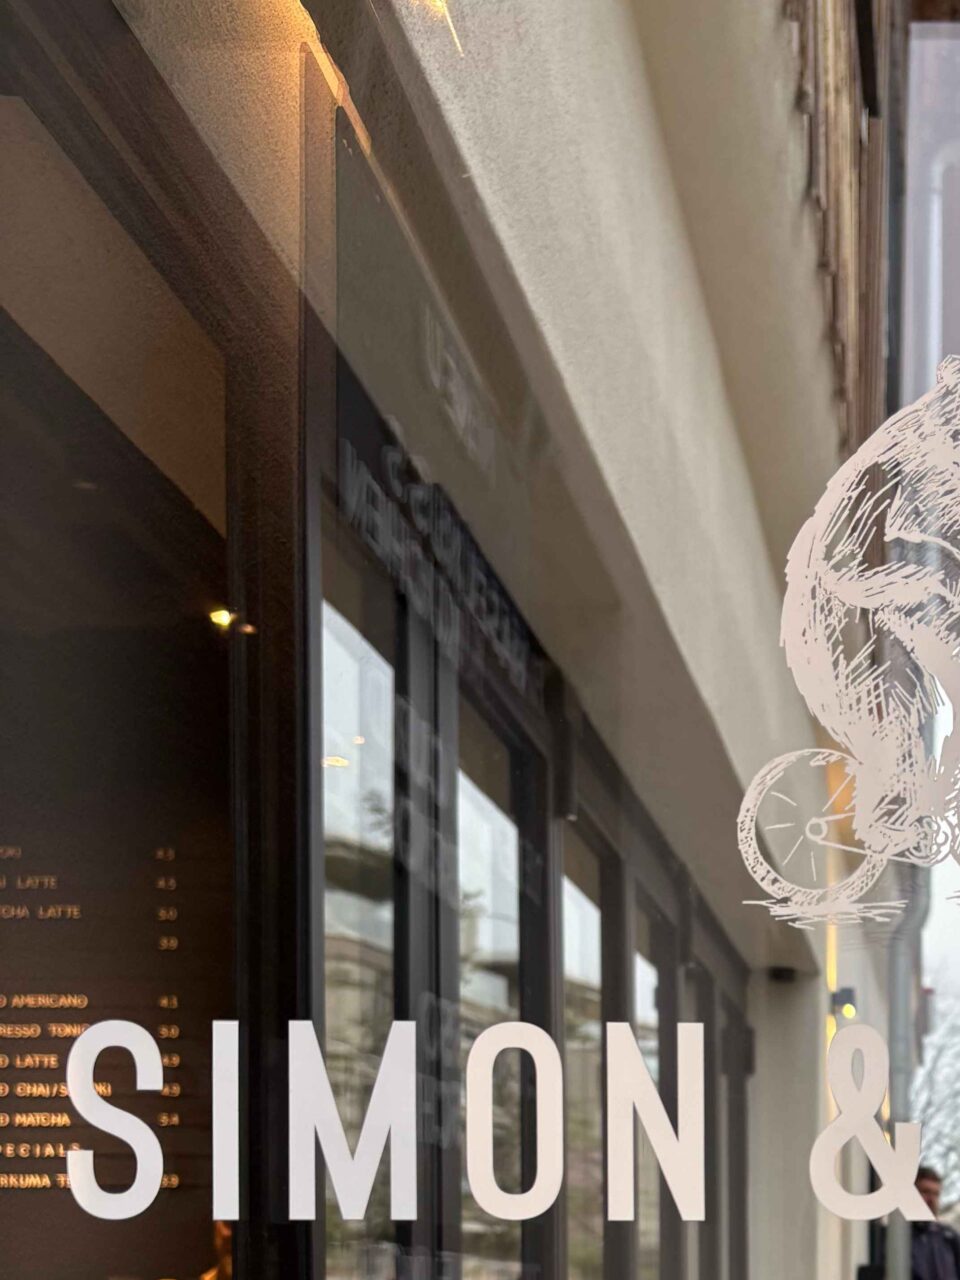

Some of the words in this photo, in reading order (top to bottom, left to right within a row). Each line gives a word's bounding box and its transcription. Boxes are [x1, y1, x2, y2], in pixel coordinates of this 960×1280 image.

[16, 875, 58, 890] LATTE
[38, 905, 82, 919] LATTE
[11, 994, 89, 1009] AMERICANO
[15, 1053, 60, 1069] LATTE
[13, 1112, 72, 1127] MATCHA
[65, 1019, 706, 1222] SIMON
[809, 1023, 937, 1221] &
